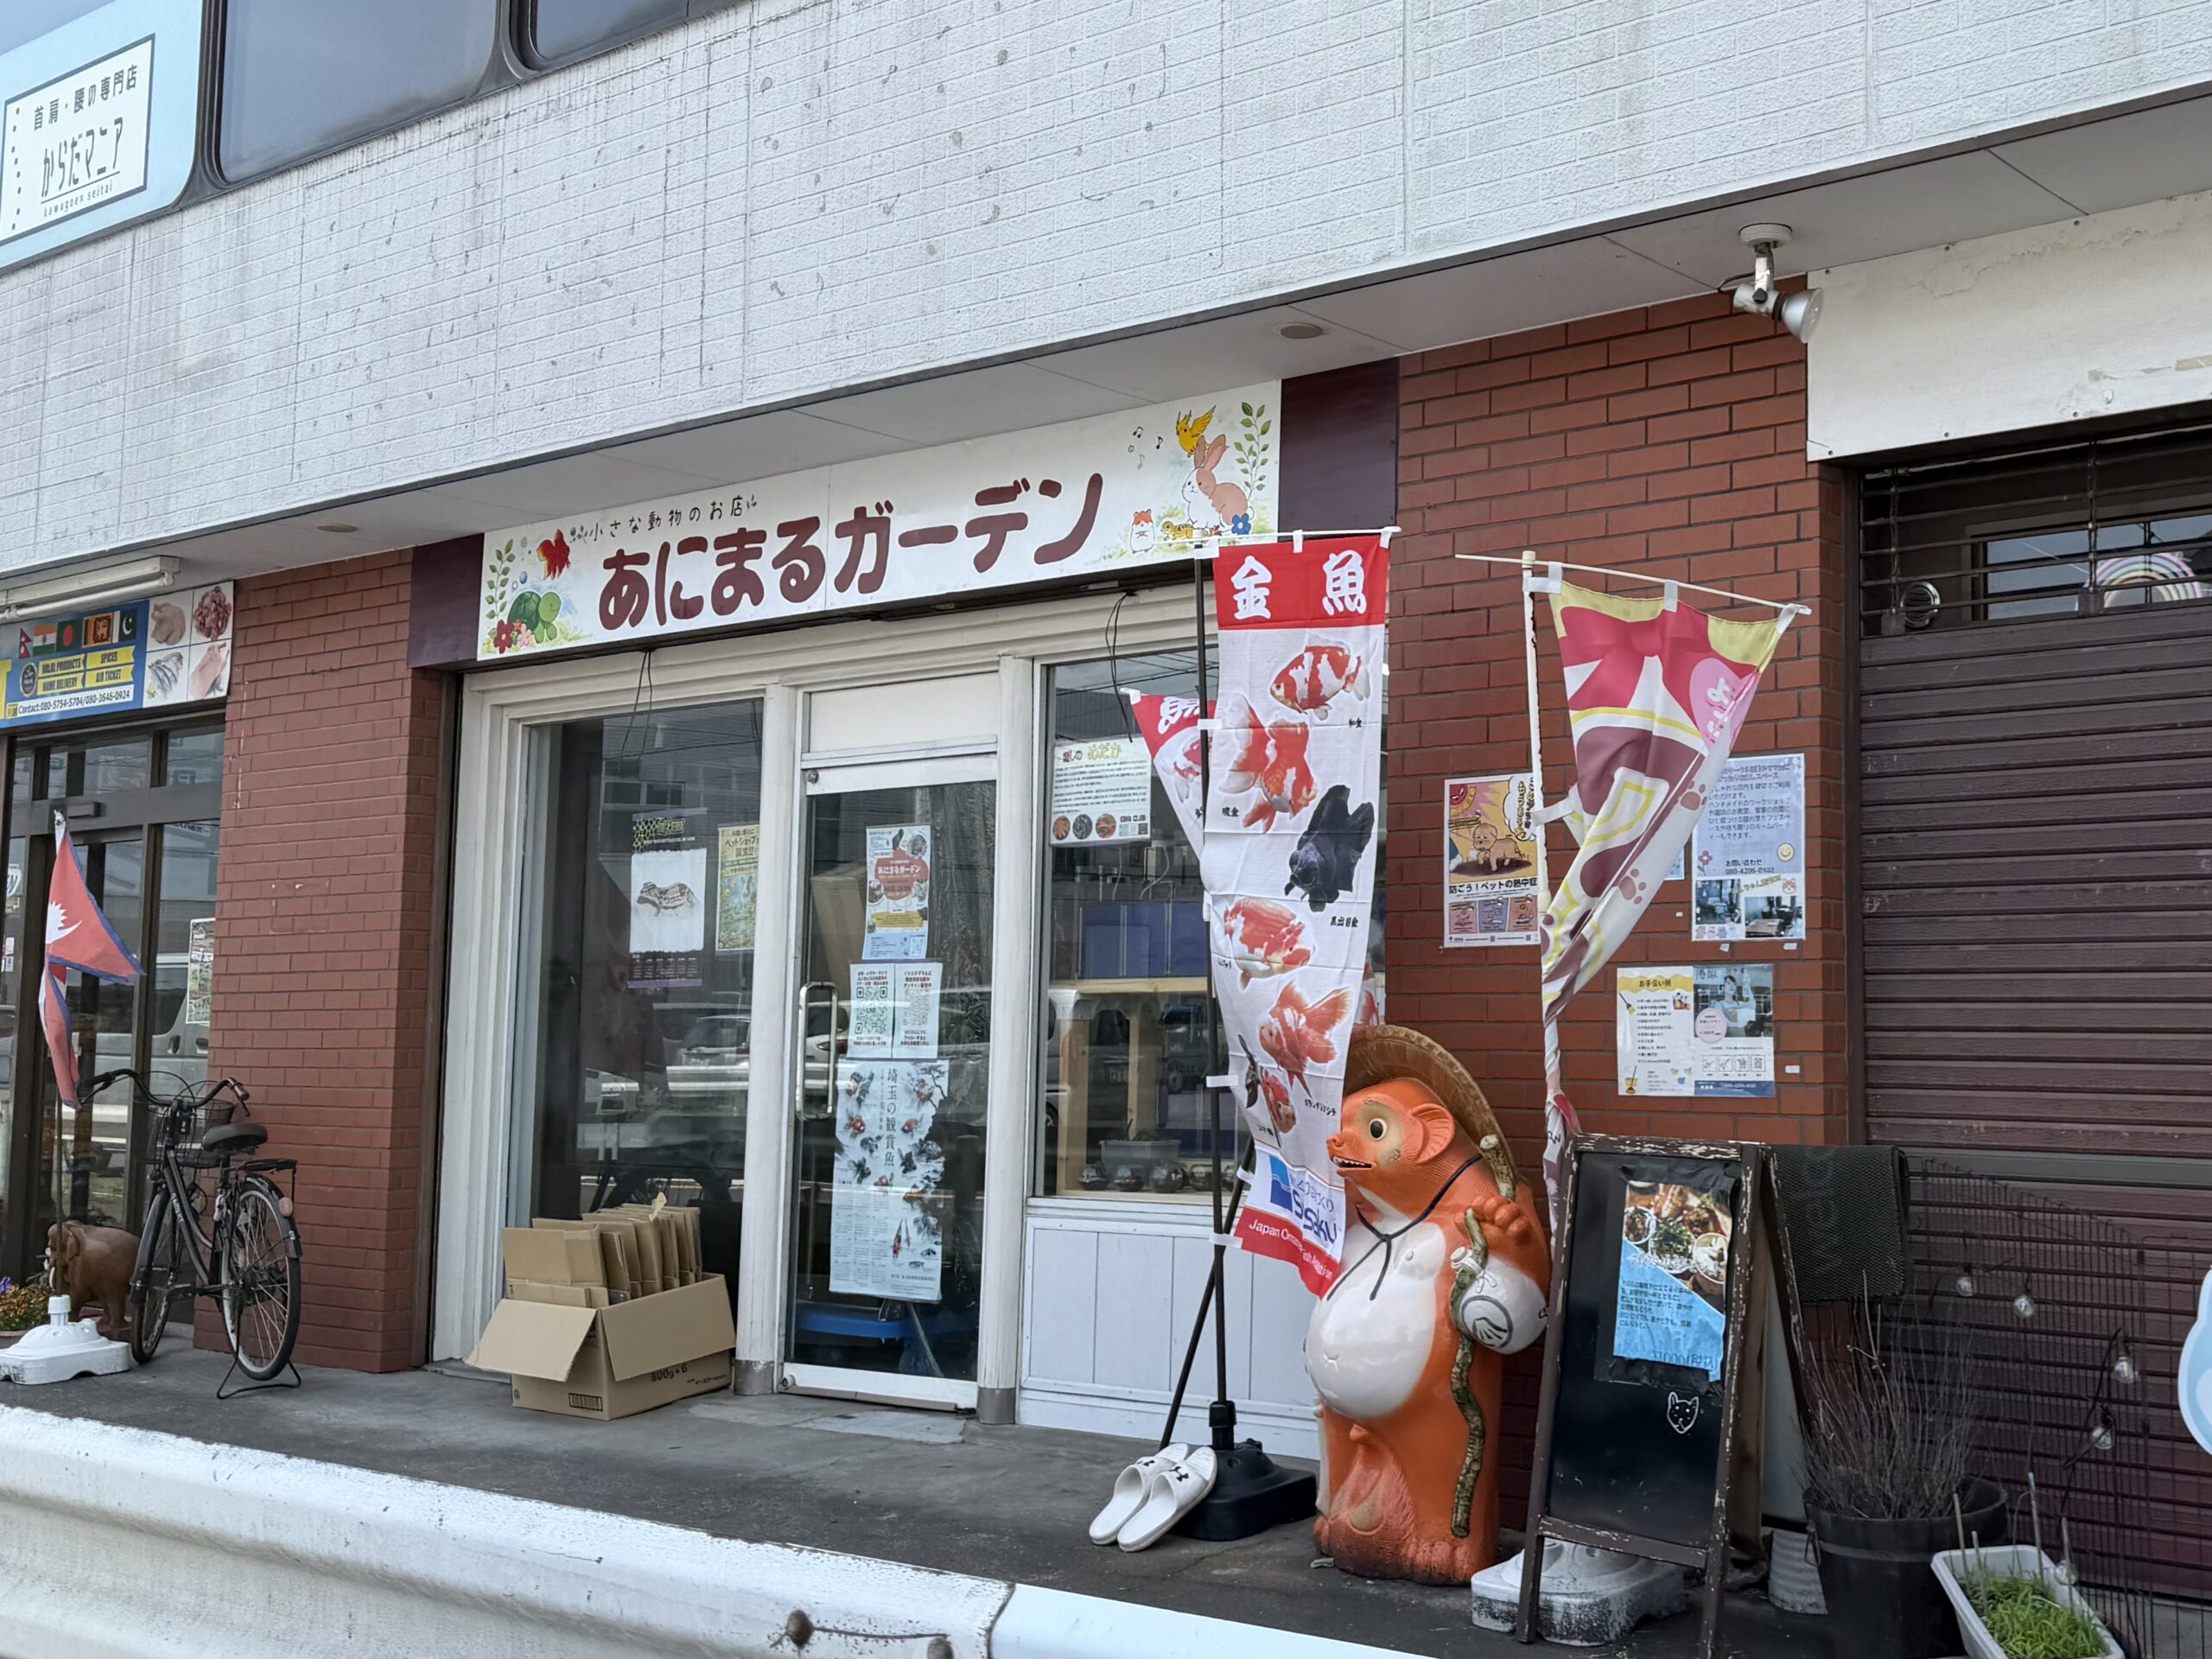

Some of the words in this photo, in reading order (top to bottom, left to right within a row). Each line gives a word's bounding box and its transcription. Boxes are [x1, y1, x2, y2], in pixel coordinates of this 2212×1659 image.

[41, 117, 124, 197] からだマニア
[589, 495, 743, 542] 小さな動物のお店
[599, 473, 1103, 631] あにまるガーデン
[1230, 550, 1367, 620] 金魚
[884, 1068, 898, 1167] 埼玉の観賞魚
[1249, 1218, 1281, 1237] Japan
